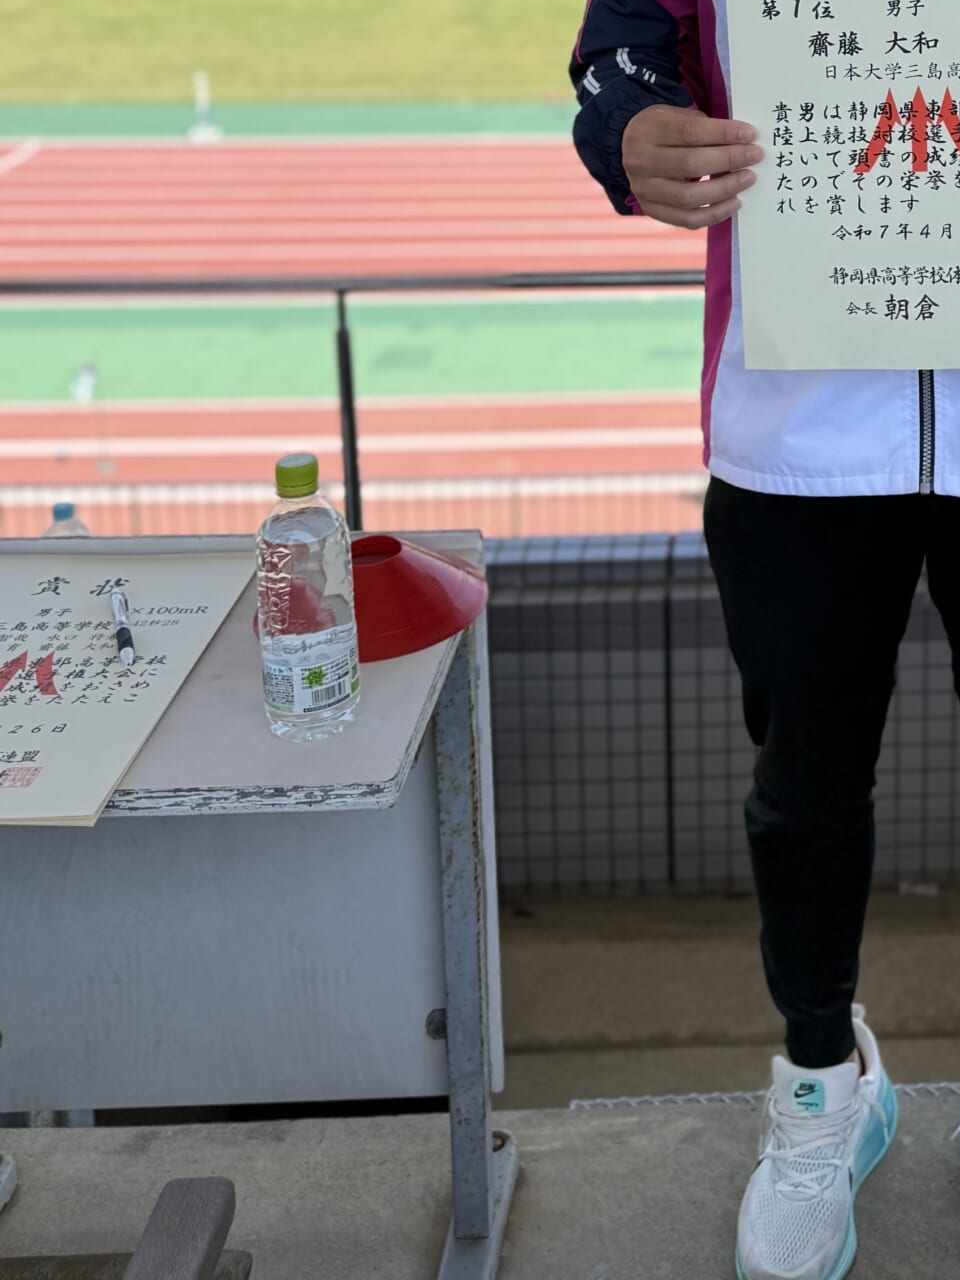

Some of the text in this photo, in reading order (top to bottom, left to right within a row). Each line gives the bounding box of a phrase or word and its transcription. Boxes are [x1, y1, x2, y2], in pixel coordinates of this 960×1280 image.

[886, 0, 926, 17] 男子
[884, 30, 940, 55] 大和
[776, 193, 920, 216] れを賞します
[845, 301, 878, 316] 会長
[883, 293, 940, 321] 朝倉
